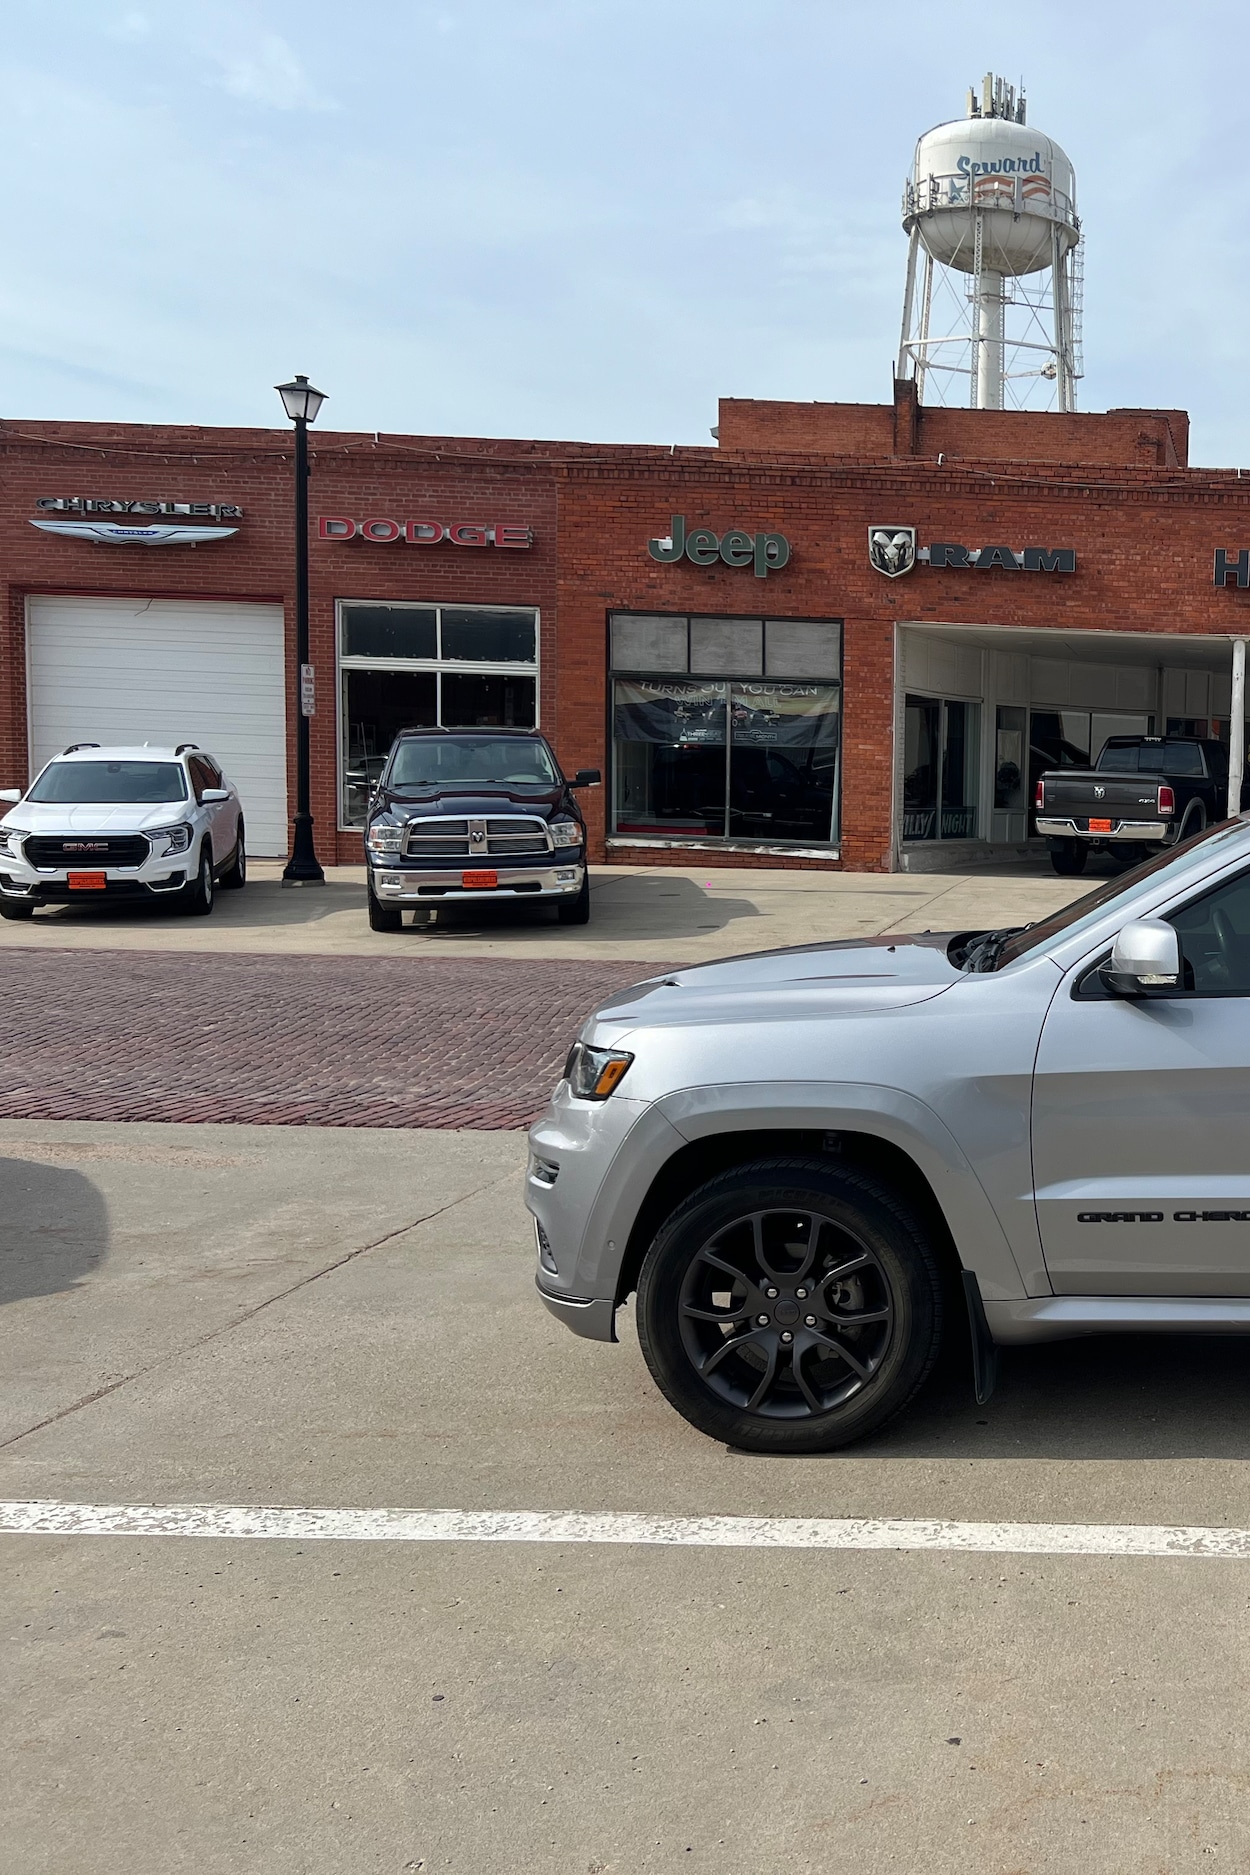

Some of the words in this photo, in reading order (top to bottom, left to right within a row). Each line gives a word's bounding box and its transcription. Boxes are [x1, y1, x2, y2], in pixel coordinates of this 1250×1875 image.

[957, 152, 1044, 179] Seward
[36, 498, 242, 518] CHRYSLER
[318, 516, 532, 549] DODGE
[648, 515, 790, 578] Jeep
[929, 543, 1075, 572] RAM
[639, 680, 697, 695] TURNS
[701, 682, 727, 693] OU
[740, 683, 776, 695] YOU
[675, 694, 713, 706] WIN
[753, 696, 781, 708] ALL
[63, 843, 109, 852] GMC
[1077, 1211, 1164, 1222] GRAND
